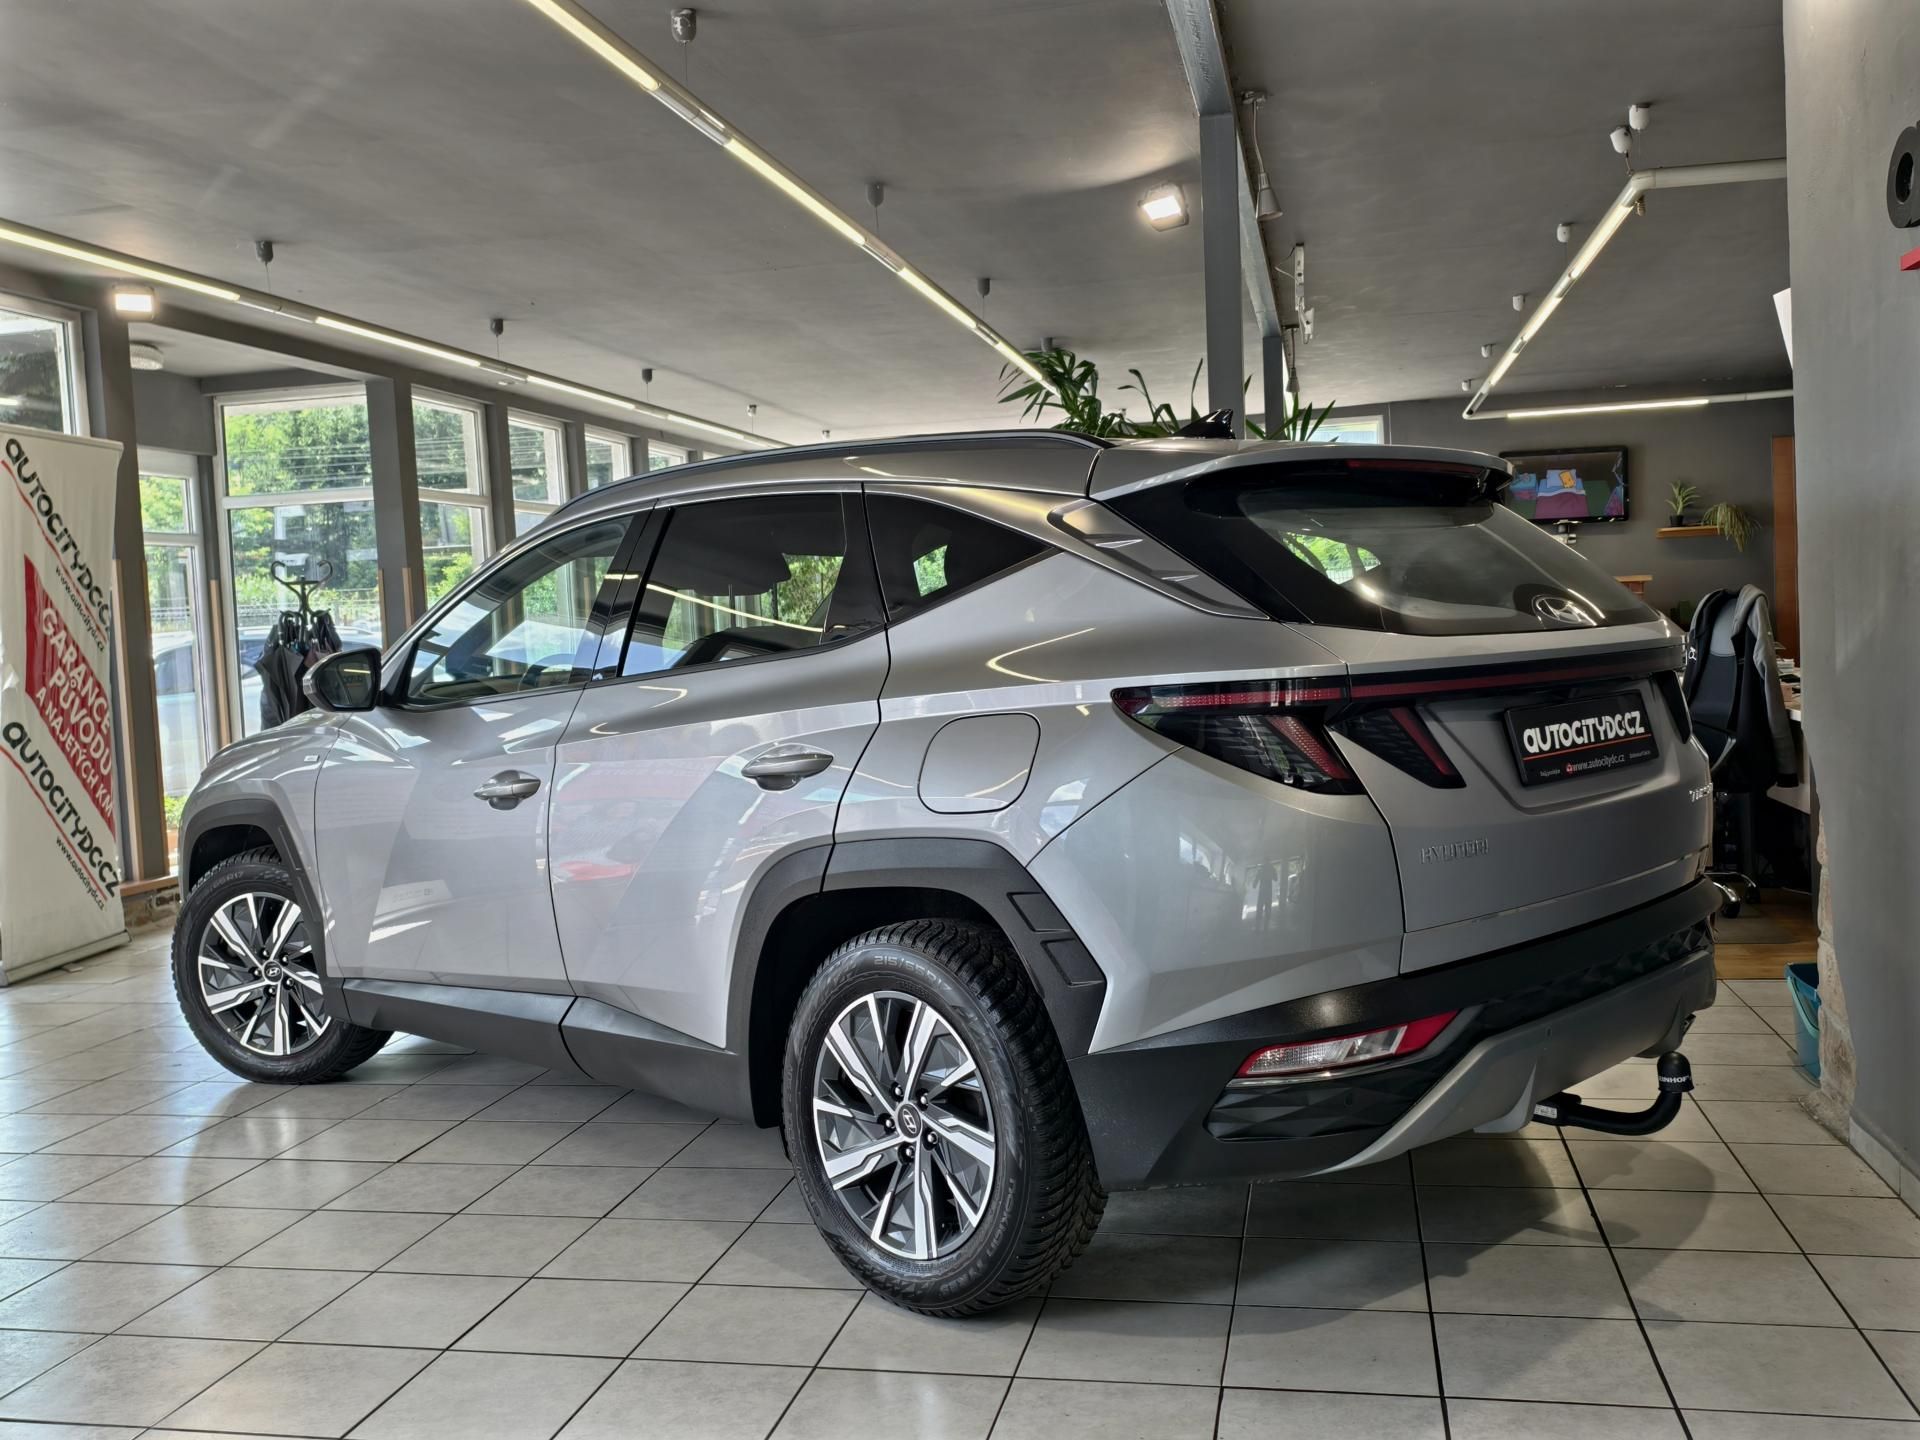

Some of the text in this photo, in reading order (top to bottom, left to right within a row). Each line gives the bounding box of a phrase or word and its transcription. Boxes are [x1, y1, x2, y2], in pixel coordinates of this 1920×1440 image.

[41, 608, 111, 735] GARANCE
[49, 667, 112, 776] PŮVODU
[36, 687, 114, 818] A NAJETÝCH KM
[55, 836, 106, 911] www.autocitydc.cz
